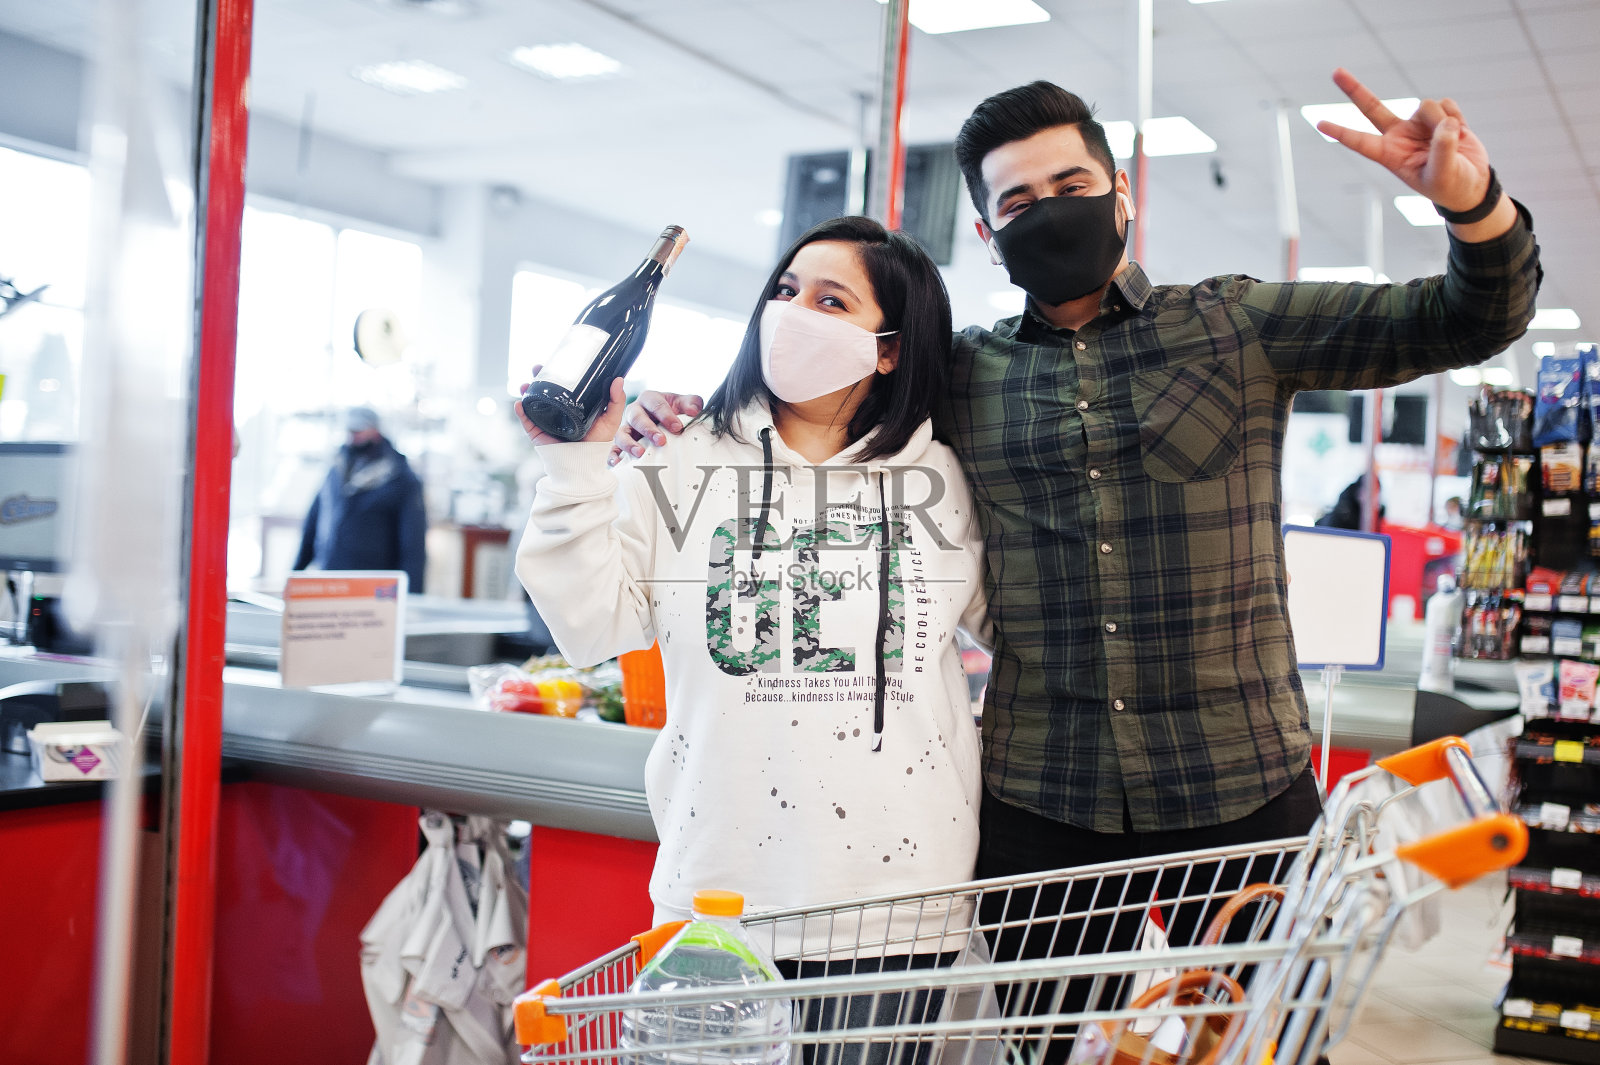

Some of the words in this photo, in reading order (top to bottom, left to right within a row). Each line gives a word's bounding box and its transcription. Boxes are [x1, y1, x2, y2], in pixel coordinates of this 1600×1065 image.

[793, 517, 808, 525] NOT
[910, 551, 924, 582] NICE
[915, 587, 928, 604] BE
[915, 611, 928, 649] COOL
[914, 656, 925, 673] BE
[758, 677, 801, 689] Kindness
[804, 677, 830, 688] Takes
[833, 676, 850, 687] You
[853, 676, 864, 686] All
[867, 676, 878, 686] Th
[885, 676, 903, 689] Way
[836, 691, 845, 701] Is
[890, 690, 915, 703] Style
